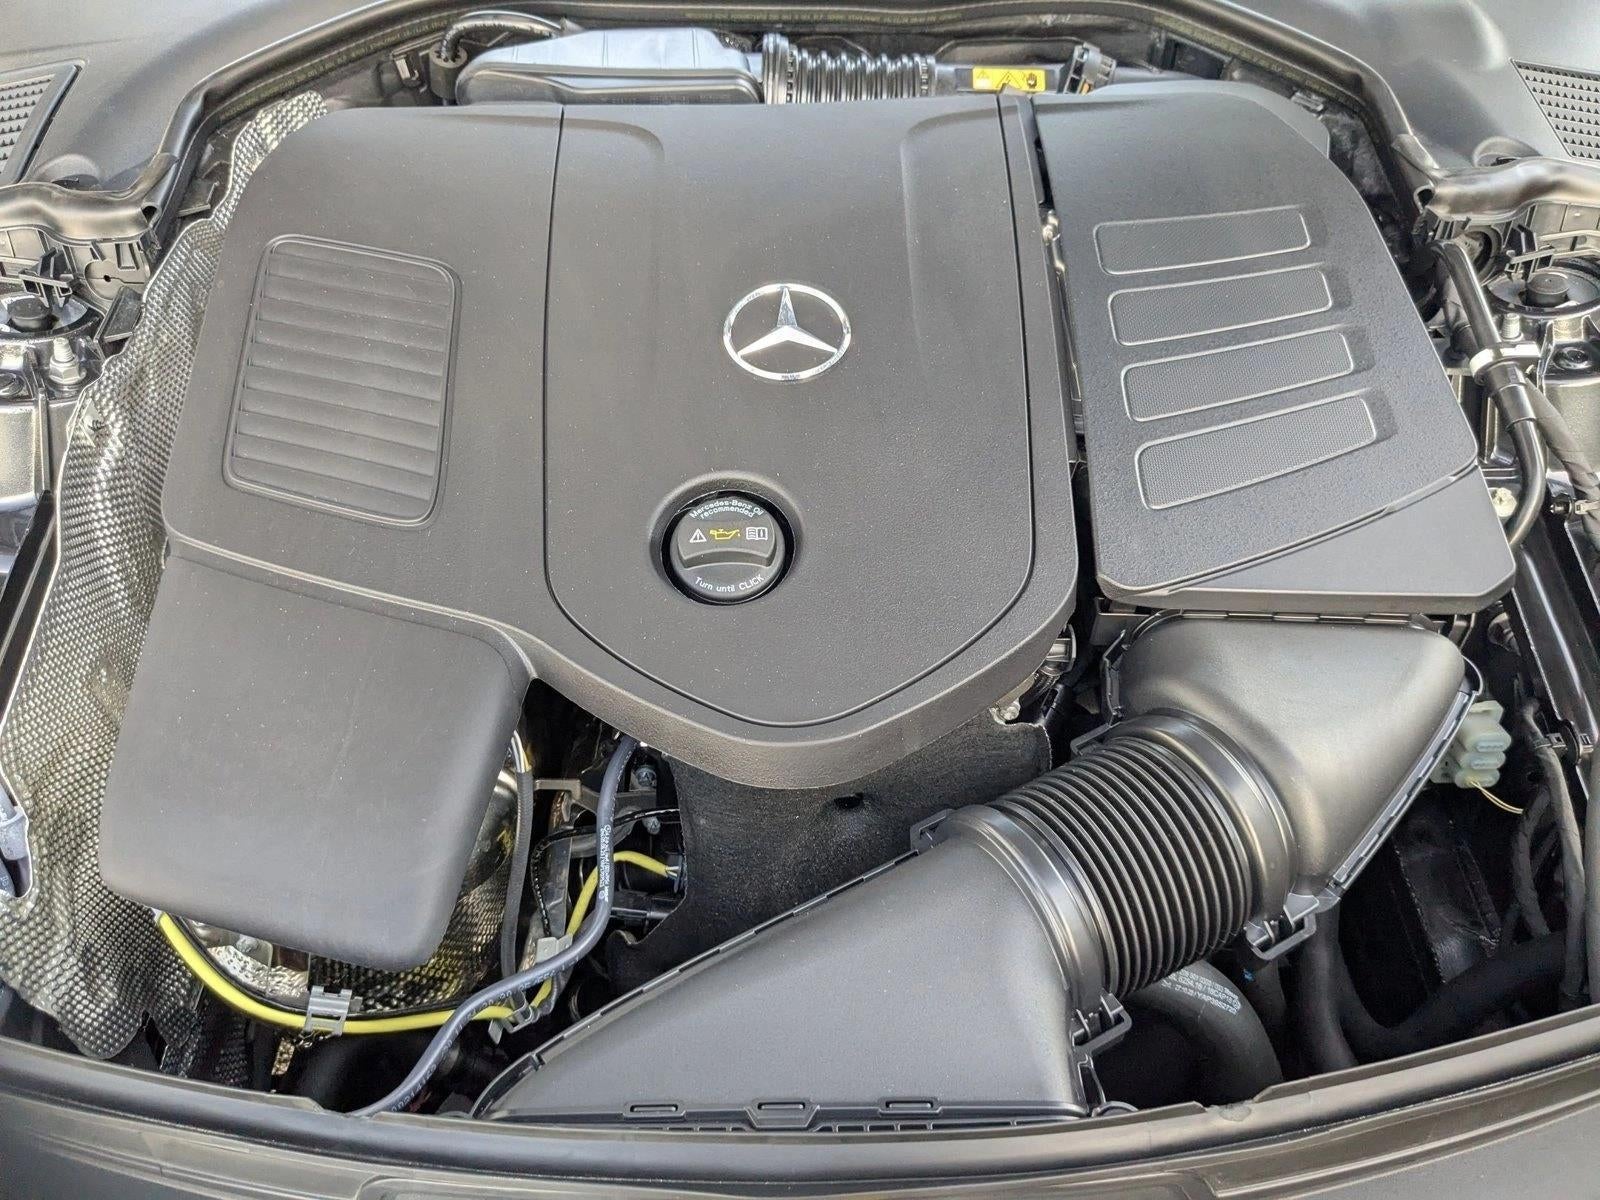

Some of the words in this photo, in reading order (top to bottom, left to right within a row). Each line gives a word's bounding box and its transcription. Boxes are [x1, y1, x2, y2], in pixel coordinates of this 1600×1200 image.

[689, 500, 752, 518] Mercedes-Benz
[700, 506, 754, 519] recommended
[695, 577, 713, 590] Turn
[738, 574, 764, 590] CLICK
